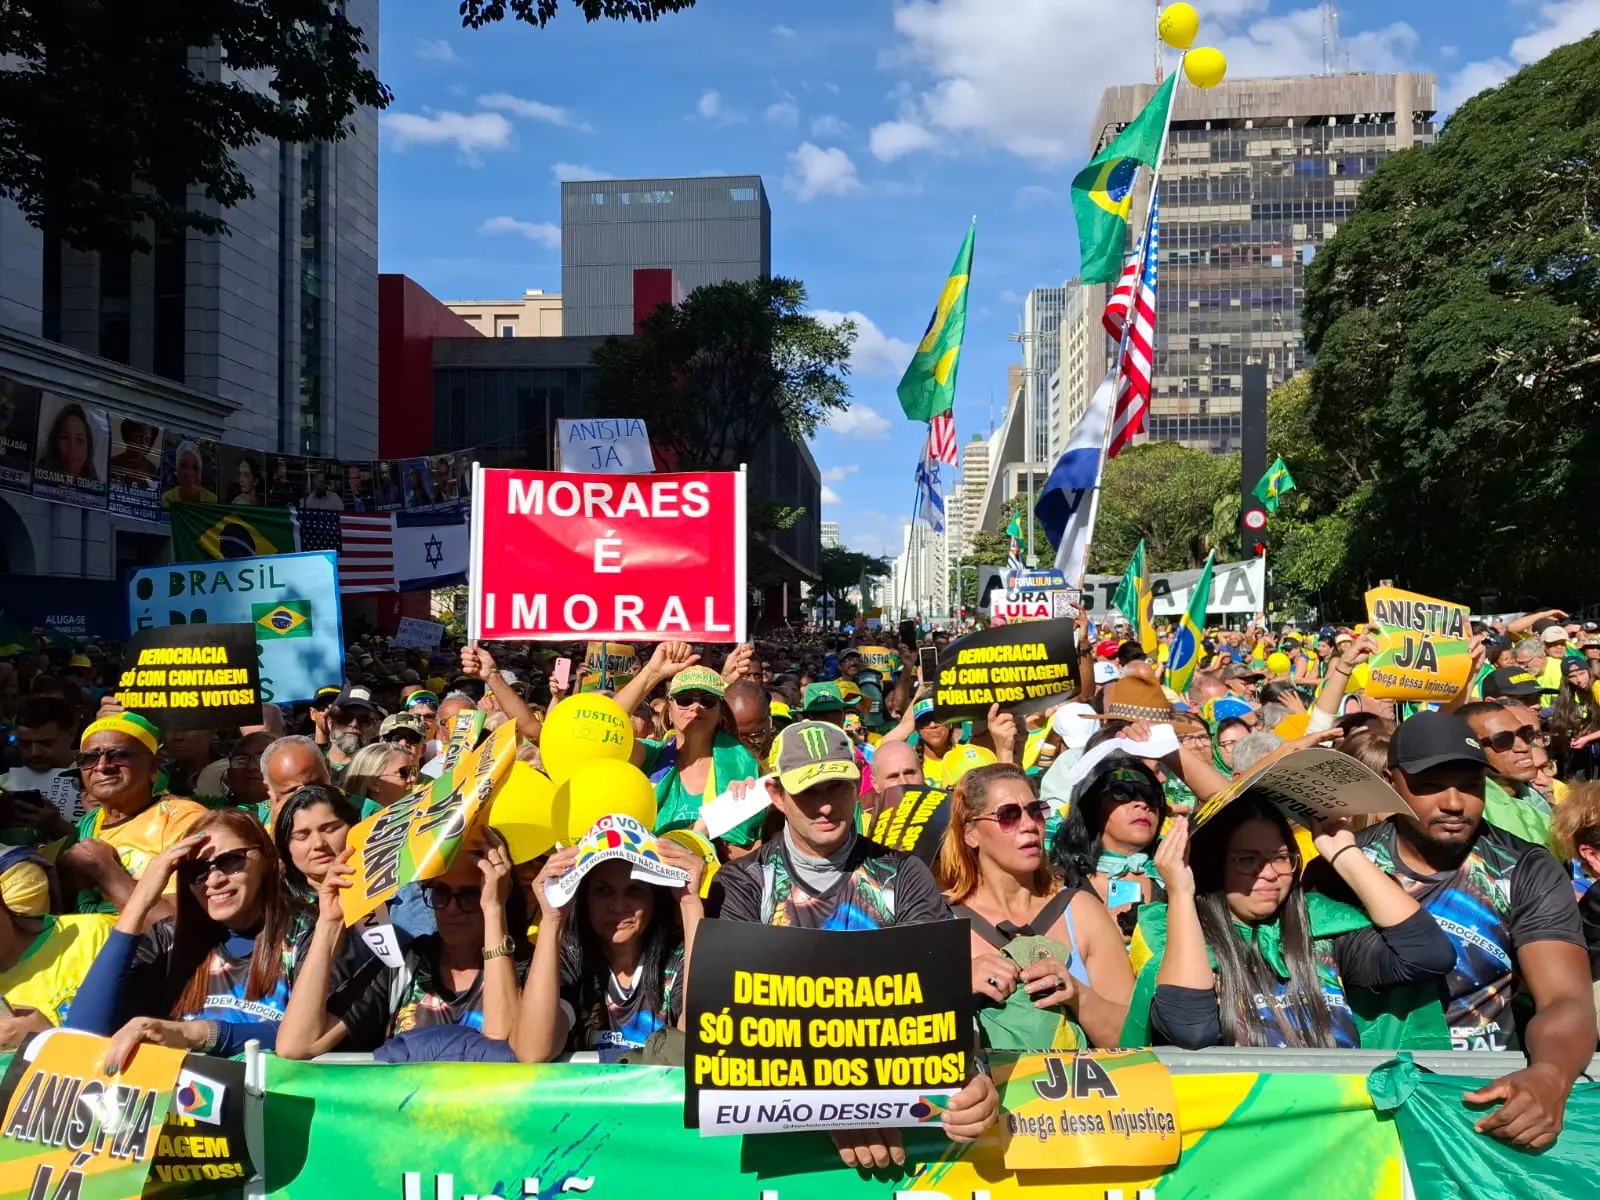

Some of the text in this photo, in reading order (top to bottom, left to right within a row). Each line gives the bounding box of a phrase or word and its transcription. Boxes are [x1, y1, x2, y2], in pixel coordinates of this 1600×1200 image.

[591, 440, 623, 469] JÁ
[508, 478, 710, 518] MORAES
[594, 529, 623, 573] É
[137, 577, 153, 600] O
[46, 615, 86, 624] ALUGA-SE
[485, 593, 730, 632] IMORAL
[994, 605, 1049, 617] LULA
[1374, 599, 1464, 639] ANISTIA
[138, 647, 228, 665] DEMOCRACIA
[958, 643, 1048, 664] DEMOCRACIA
[1394, 633, 1438, 673] JÁ
[119, 668, 248, 687] SÓ COM CONTAGEM
[940, 663, 1069, 686] SÓ COM CONTAGEM
[1372, 670, 1459, 695] Chega dessa Injustiça
[170, 691, 200, 707] DOS
[202, 689, 254, 706] VOTOS!
[937, 679, 1075, 705] PÚBLICA DOS VOTOS!
[573, 709, 625, 728] JUSTIÇA
[601, 729, 624, 745] JÁ!
[415, 777, 467, 840] JÁ
[362, 788, 430, 899] ANISTIA
[560, 868, 582, 890] ESSA
[580, 850, 625, 872] VERGONHA
[626, 850, 637, 862] EU
[638, 852, 655, 871] NÃO
[368, 932, 391, 956] EU
[1440, 918, 1506, 960] PROGRESSO
[734, 970, 923, 1008] DEMOCRACIA
[700, 1008, 956, 1048] SÓ COM CONTAGEM
[694, 1049, 966, 1088] PÚBLICA DOS VOTOS!
[3, 1069, 158, 1161] ANISTIA
[716, 1104, 751, 1125] EU
[757, 1098, 814, 1123] NÃO
[1008, 1106, 1177, 1141] Chega dessa Injustiça
[154, 1162, 245, 1182] VOTOS!
